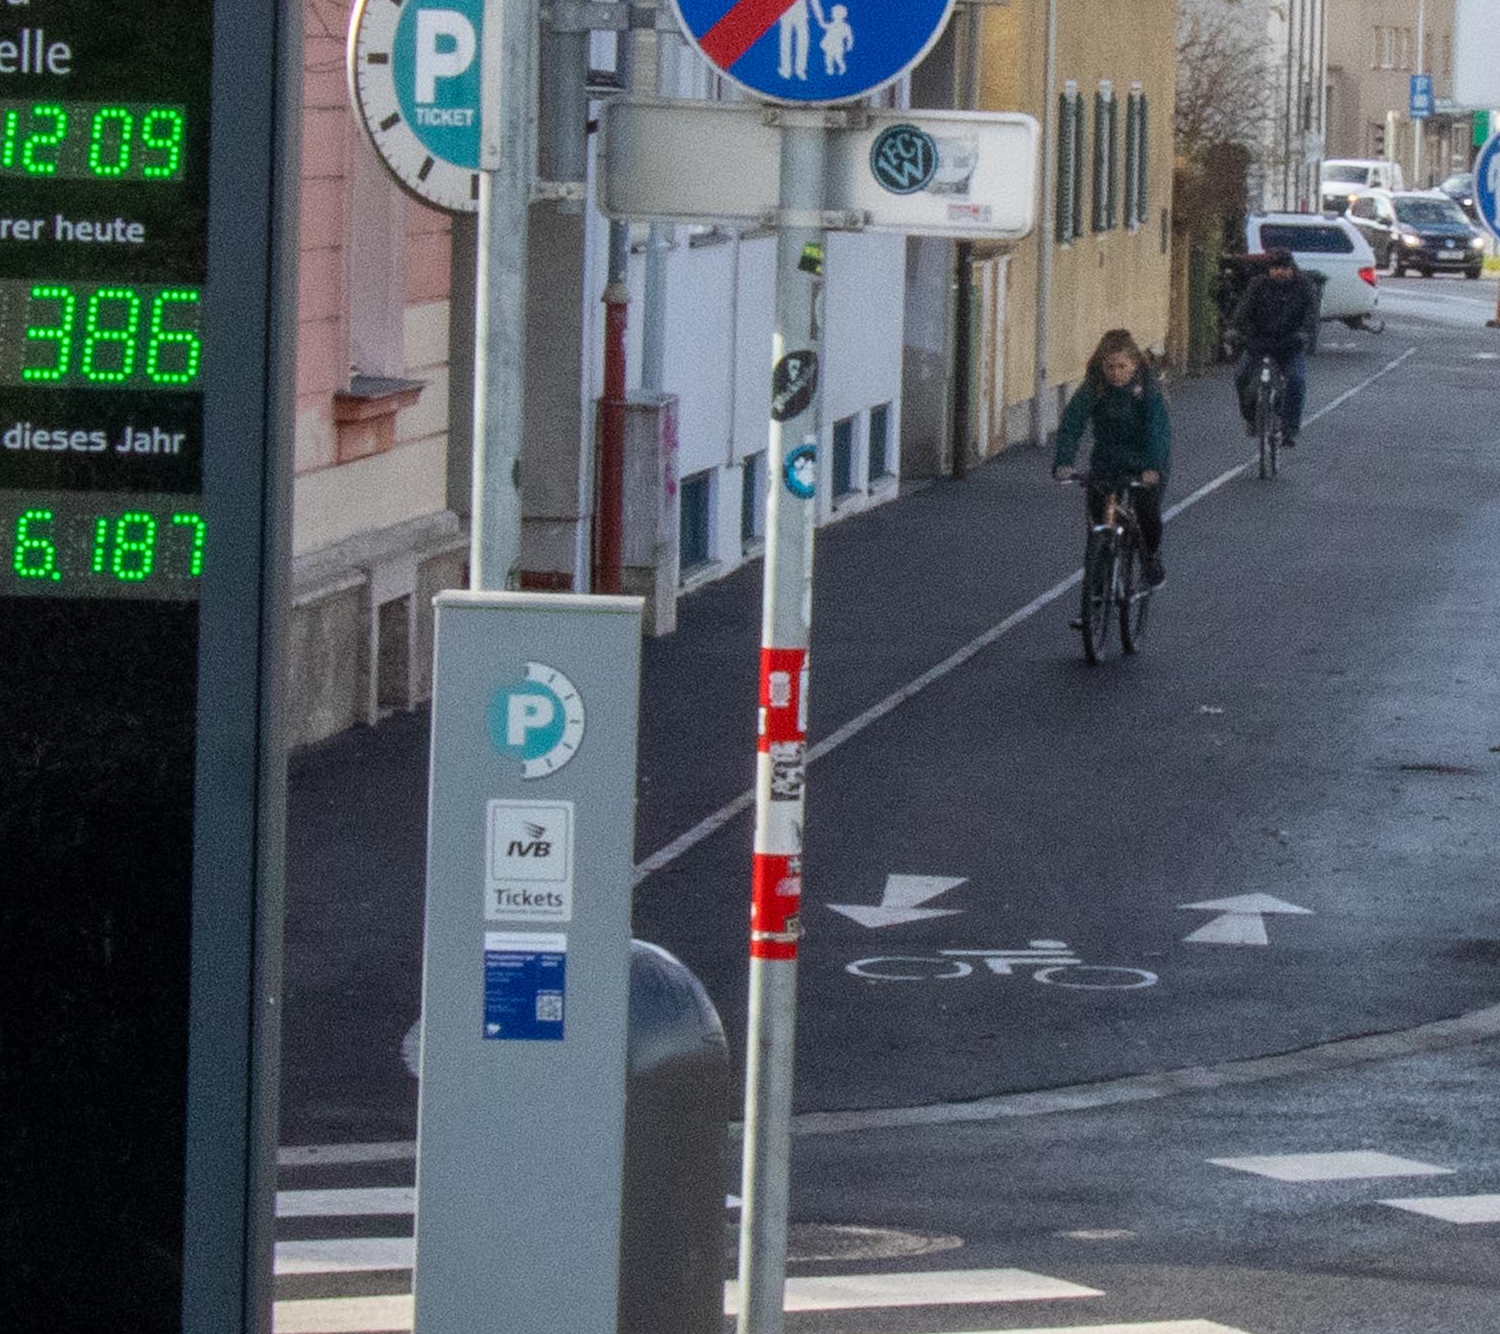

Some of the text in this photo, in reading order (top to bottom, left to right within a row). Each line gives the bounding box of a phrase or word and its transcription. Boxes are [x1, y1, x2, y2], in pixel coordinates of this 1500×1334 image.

[415, 9, 476, 103] P
[414, 107, 475, 127] TICKET
[55, 214, 146, 245] heute
[21, 284, 202, 386] 386
[3, 422, 108, 452] dieses
[116, 425, 186, 454] Jahr
[507, 693, 555, 746] P
[506, 840, 552, 858] IVB
[495, 888, 564, 907] Tickets
